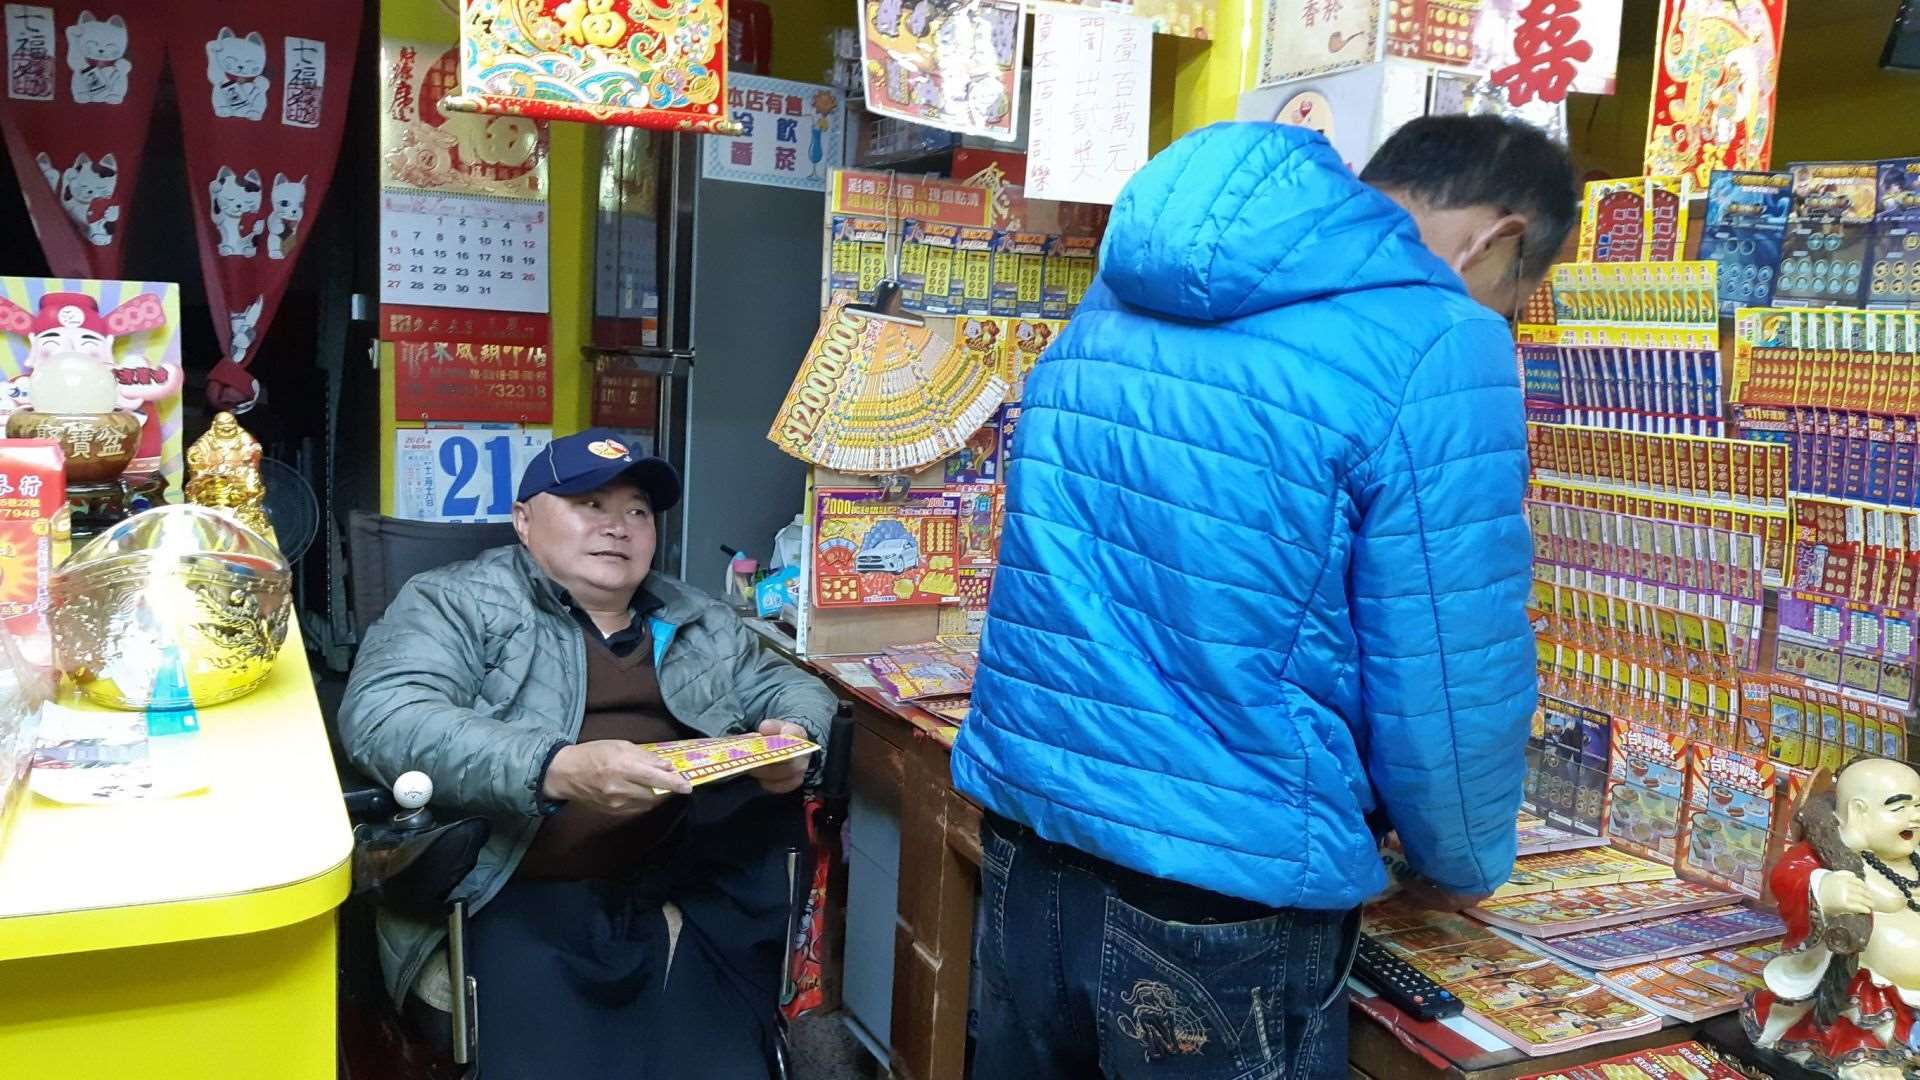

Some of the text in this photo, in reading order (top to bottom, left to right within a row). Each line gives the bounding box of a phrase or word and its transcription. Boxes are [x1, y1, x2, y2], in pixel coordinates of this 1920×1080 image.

[1104, 24, 1137, 173] 壹百萬元
[482, 220, 488, 228] 3
[391, 230, 398, 238] 6
[413, 231, 421, 239] 7
[459, 235, 466, 243] 9
[480, 237, 491, 245] 10
[388, 246, 400, 254] 13
[411, 248, 424, 256] 14
[434, 250, 446, 258] 15
[456, 252, 469, 260] 16
[501, 255, 513, 263] 18
[522, 257, 535, 265] 19
[456, 268, 469, 276] 23
[500, 271, 513, 279] 25
[522, 273, 535, 281] 26
[387, 280, 400, 288] 27
[410, 281, 424, 289] 28
[433, 283, 446, 291] 29
[439, 436, 513, 517] 21
